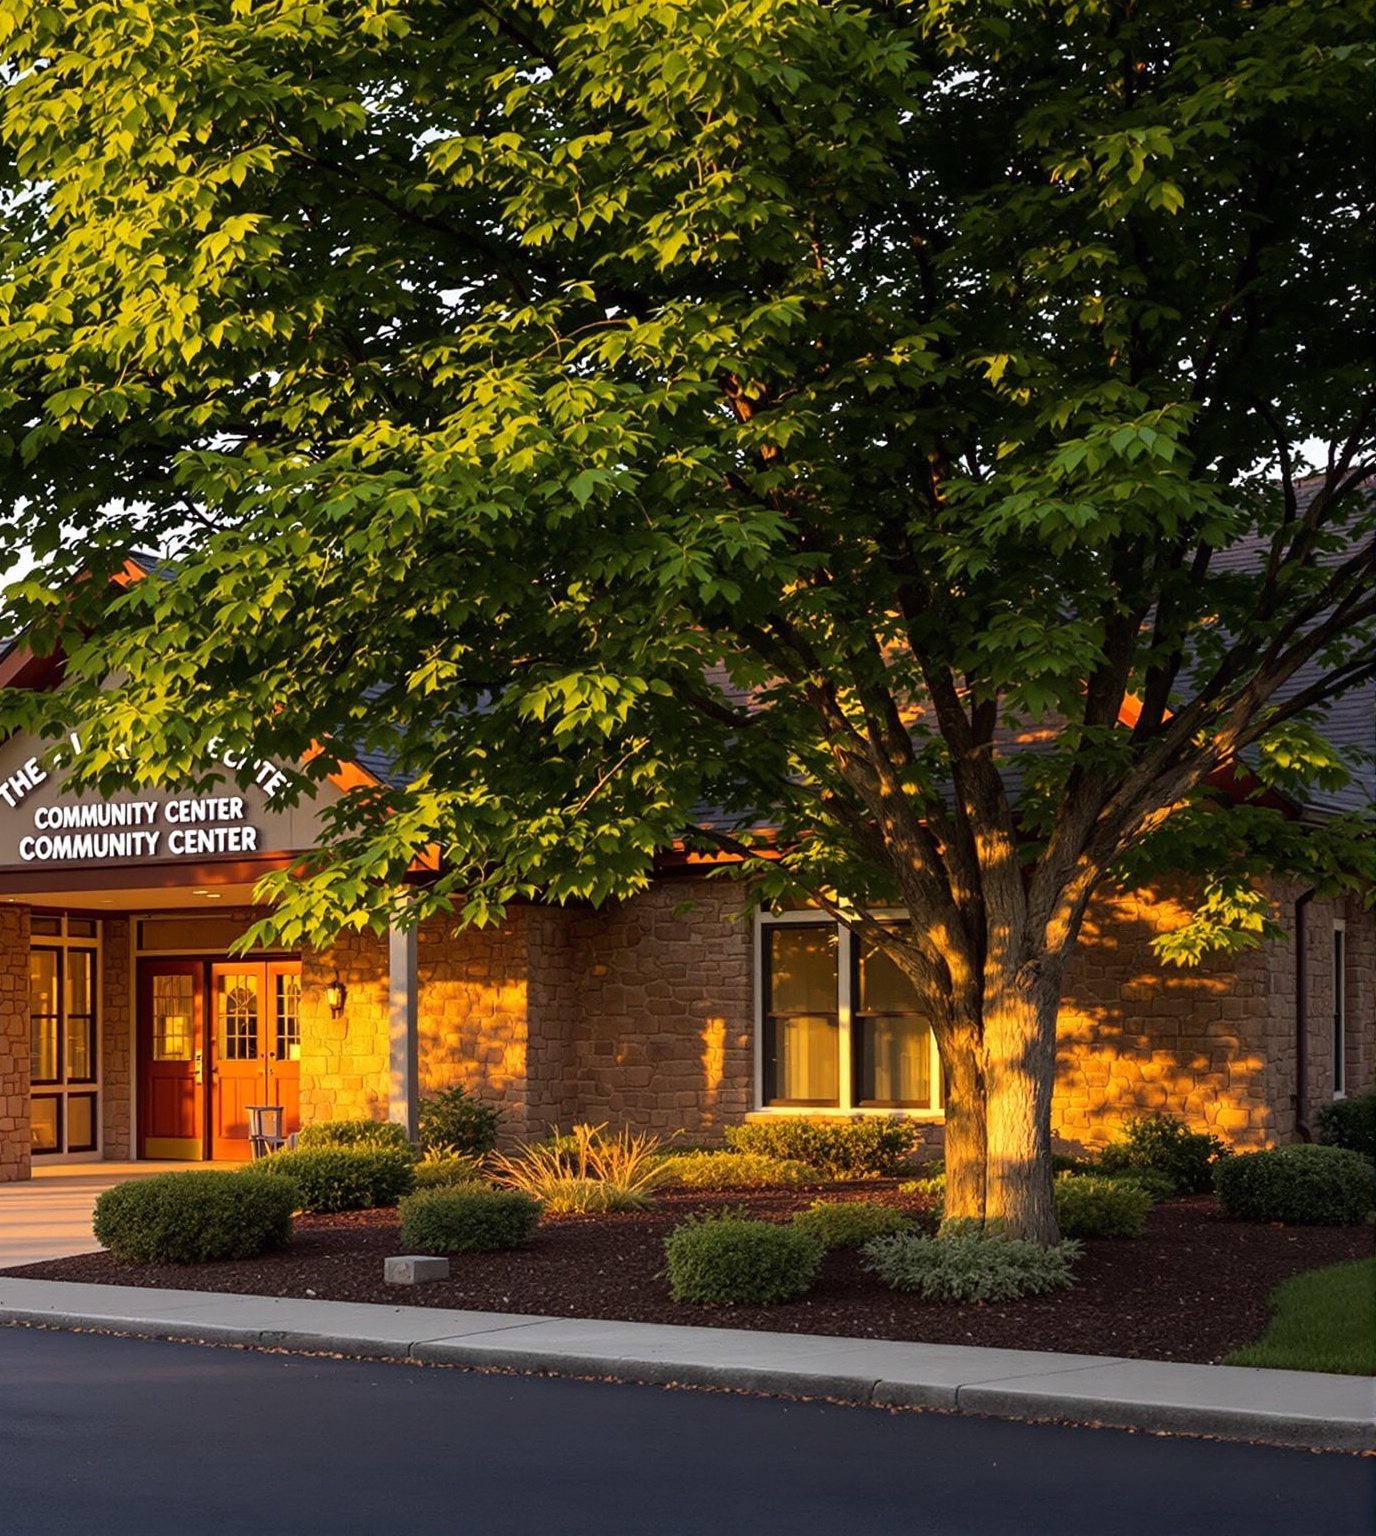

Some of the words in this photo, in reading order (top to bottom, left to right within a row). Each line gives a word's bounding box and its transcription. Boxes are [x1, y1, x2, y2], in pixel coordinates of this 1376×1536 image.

[34, 801, 158, 830] COMMUNITY
[164, 796, 244, 823] CENTER
[19, 830, 160, 861] COMMUNITY
[168, 826, 257, 855] CENTER
